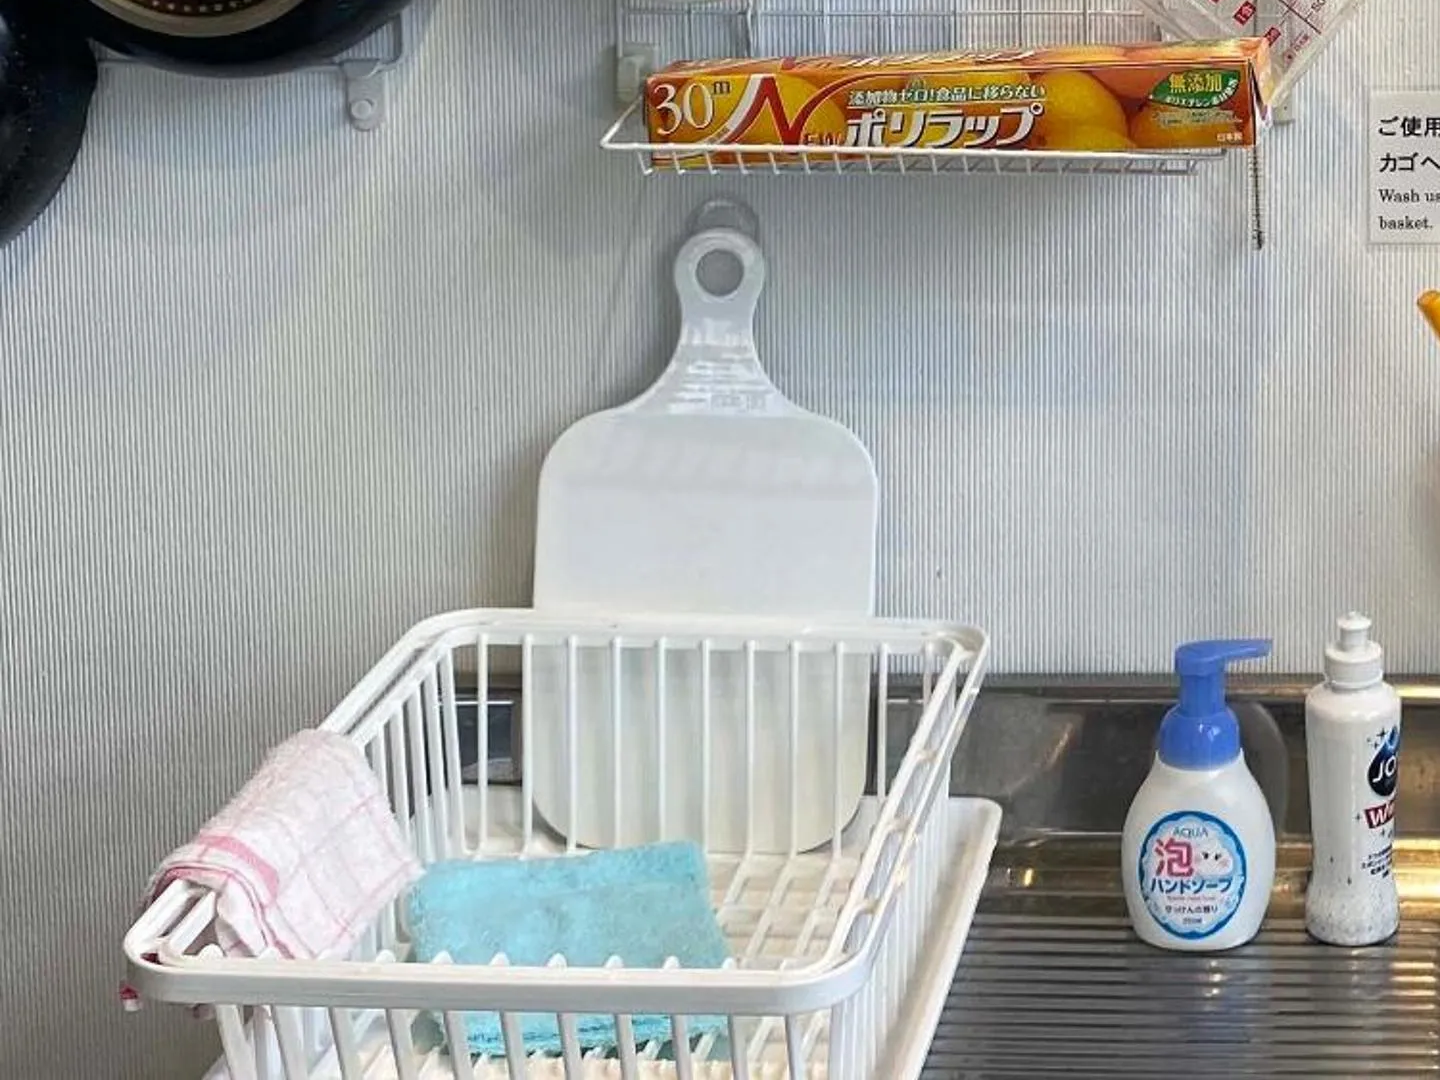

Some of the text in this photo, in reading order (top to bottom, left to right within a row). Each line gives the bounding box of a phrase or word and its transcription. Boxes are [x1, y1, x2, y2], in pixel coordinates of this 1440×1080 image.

[1169, 72, 1222, 94] 無添加
[844, 103, 1045, 147] ポリラップ
[1379, 188, 1420, 202] Wash
[1379, 216, 1434, 230] basket.
[1173, 827, 1208, 838] AQUA
[1155, 838, 1194, 877] 泡
